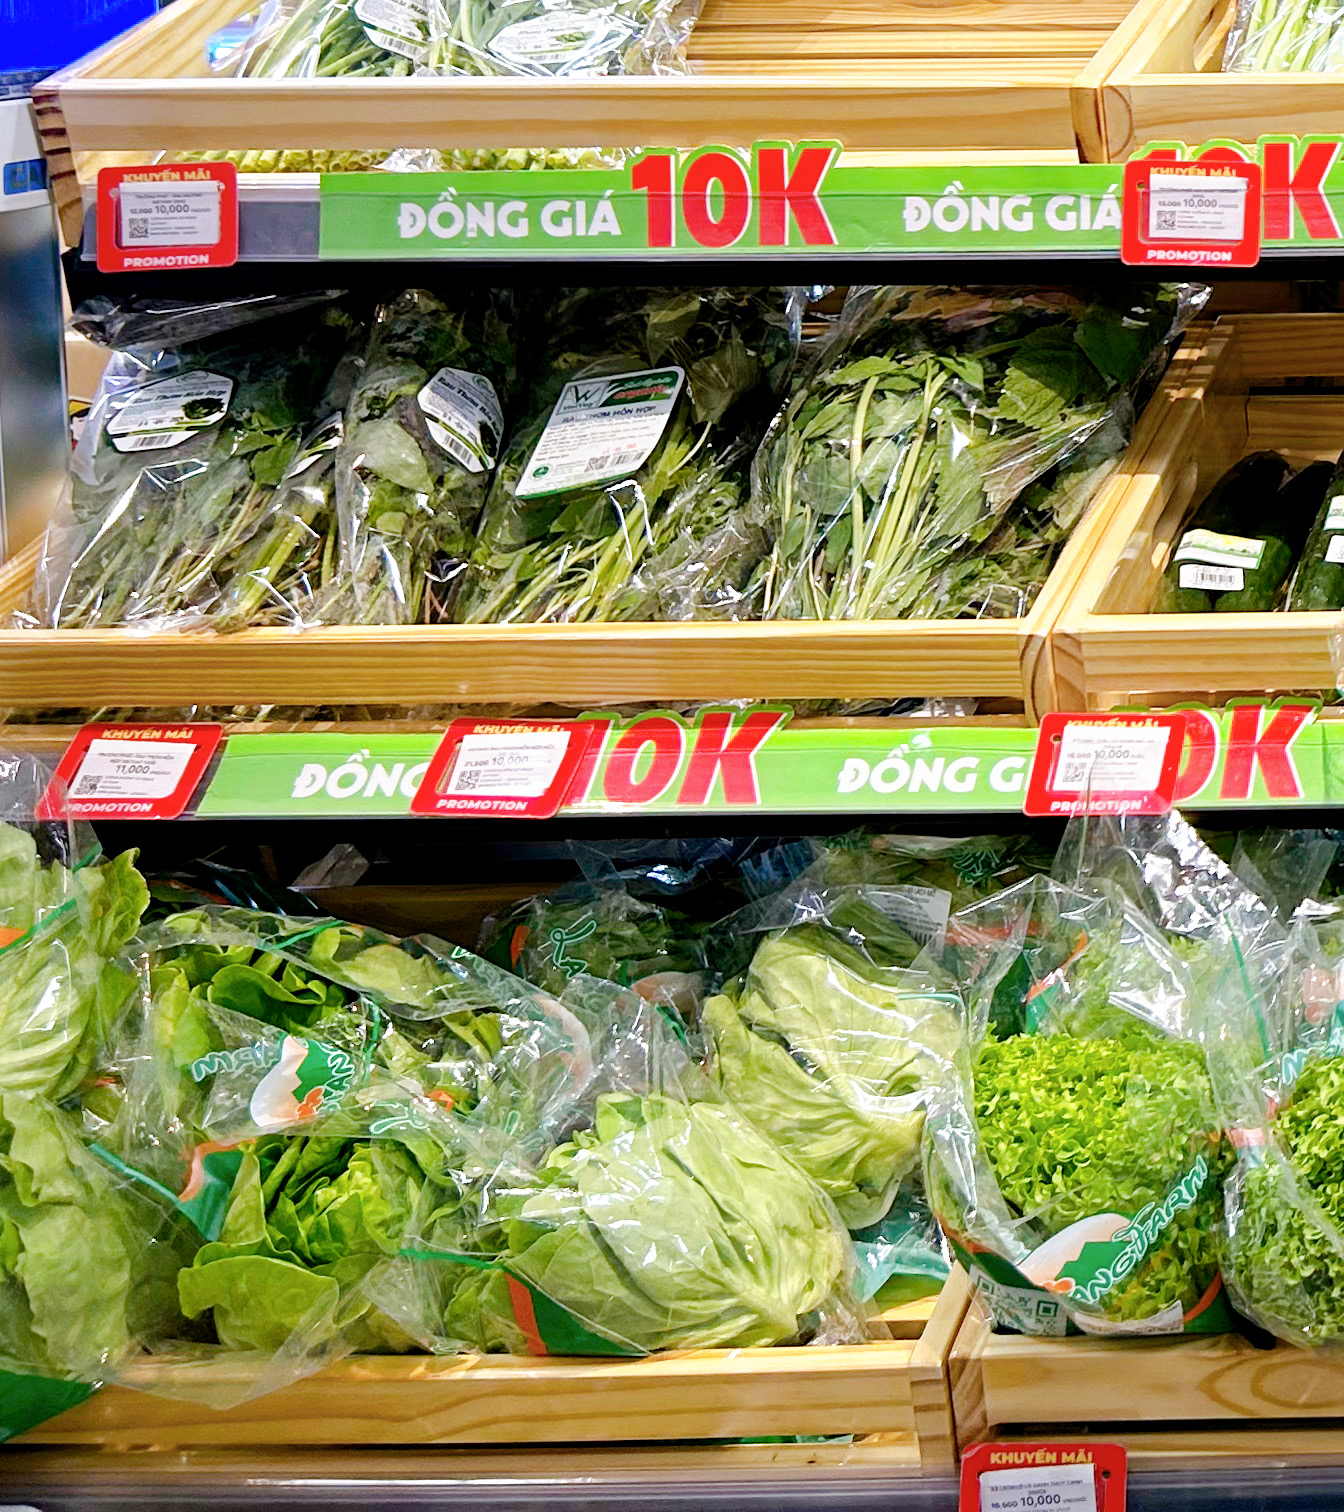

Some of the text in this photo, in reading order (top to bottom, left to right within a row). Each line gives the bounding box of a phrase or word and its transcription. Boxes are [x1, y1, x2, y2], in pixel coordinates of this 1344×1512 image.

[123, 167, 212, 183] KHUYẾN MÃI
[1150, 164, 1237, 177] KHUYẾN MÃI
[397, 147, 841, 248] ĐỒNG GIÁ 10K
[1183, 198, 1218, 210] 10,000
[155, 204, 190, 216] 10,000
[902, 180, 1033, 233] ĐỒNG
[1044, 183, 1122, 231] GIÁ
[123, 254, 210, 268] PROMOTION
[1146, 249, 1233, 262] PROMOTION
[101, 725, 194, 741] KHUYẾN MÃI
[1093, 748, 1131, 761] 10,000
[115, 763, 151, 777] 11,000
[837, 731, 980, 795] ĐỒNG
[63, 800, 154, 814] PROMOTION
[436, 798, 529, 813] PROMOTION
[1049, 800, 1143, 814] PROMOTION
[989, 1447, 1094, 1465] KHUYẾN MÃI
[1019, 1494, 1061, 1509] 10,000
